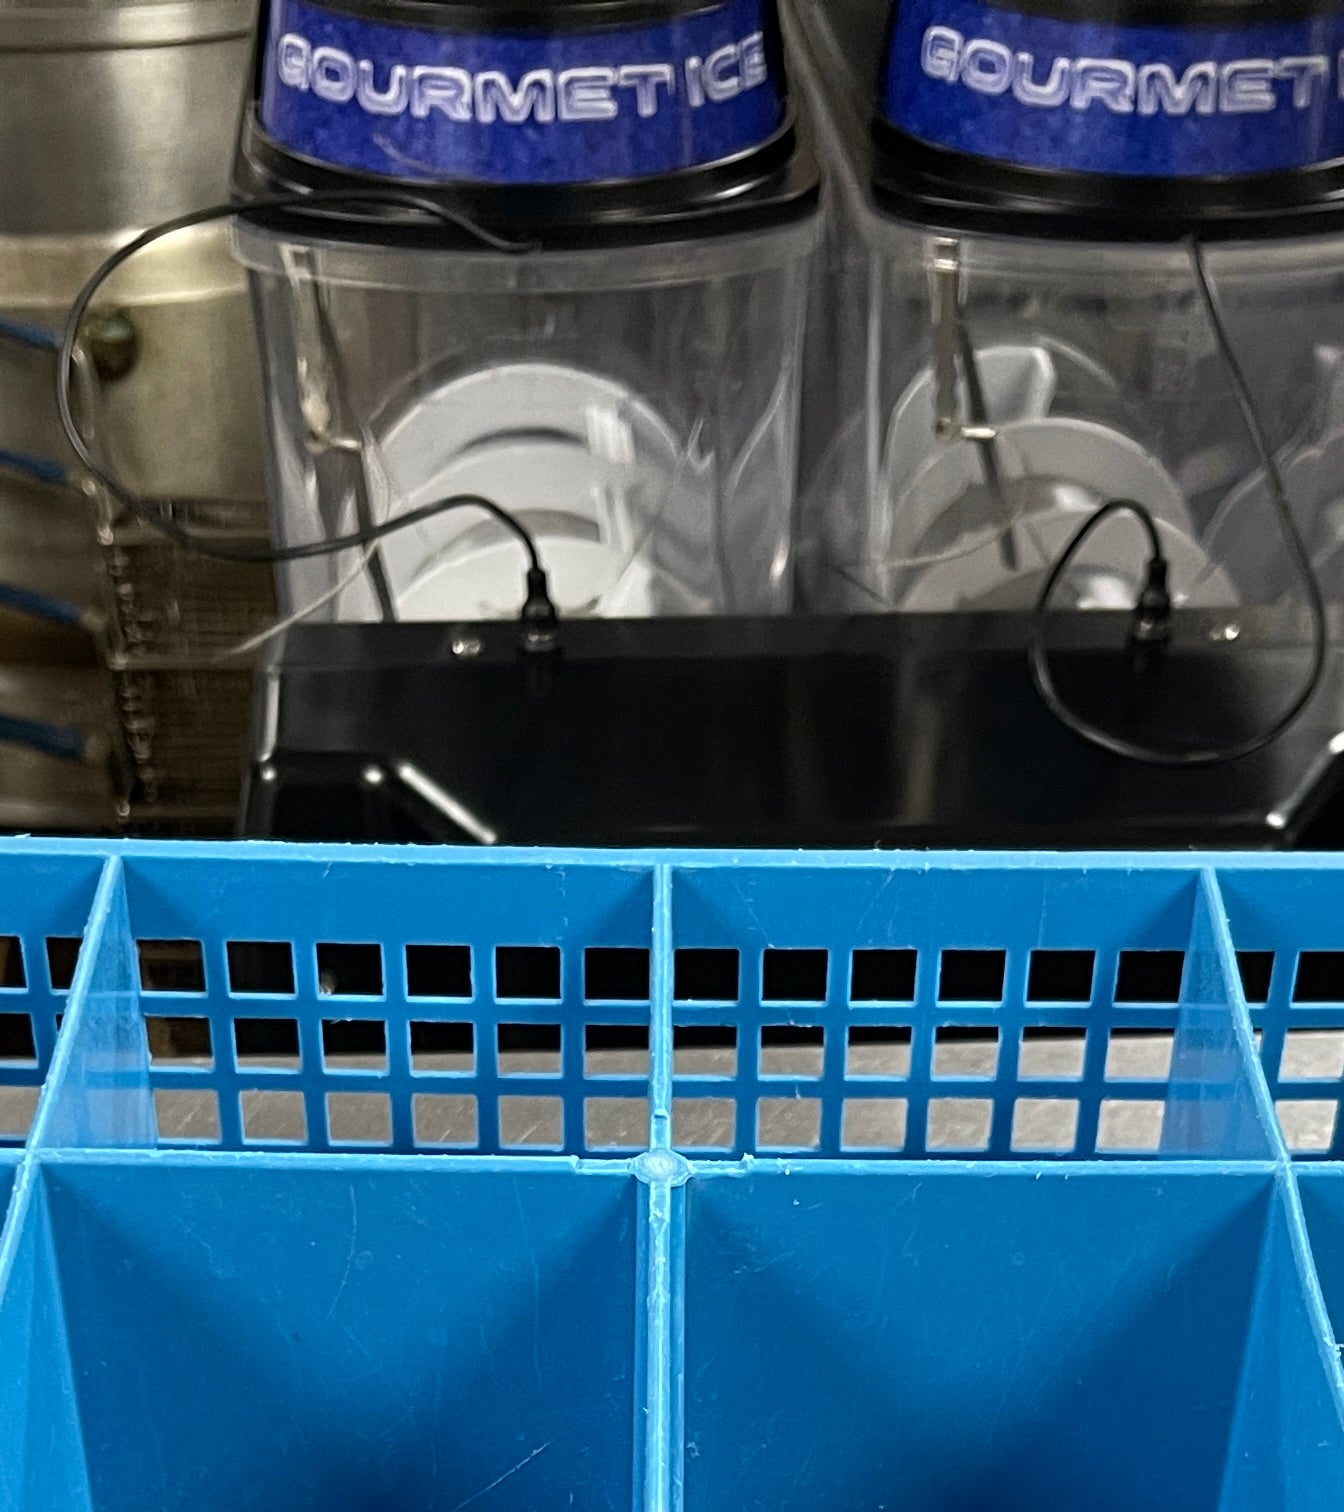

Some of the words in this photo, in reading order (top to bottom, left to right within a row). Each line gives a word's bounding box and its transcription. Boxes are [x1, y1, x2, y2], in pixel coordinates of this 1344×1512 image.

[277, 32, 675, 124] GOURMET
[685, 31, 768, 107] ICE
[921, 25, 1329, 116] GOURMET
